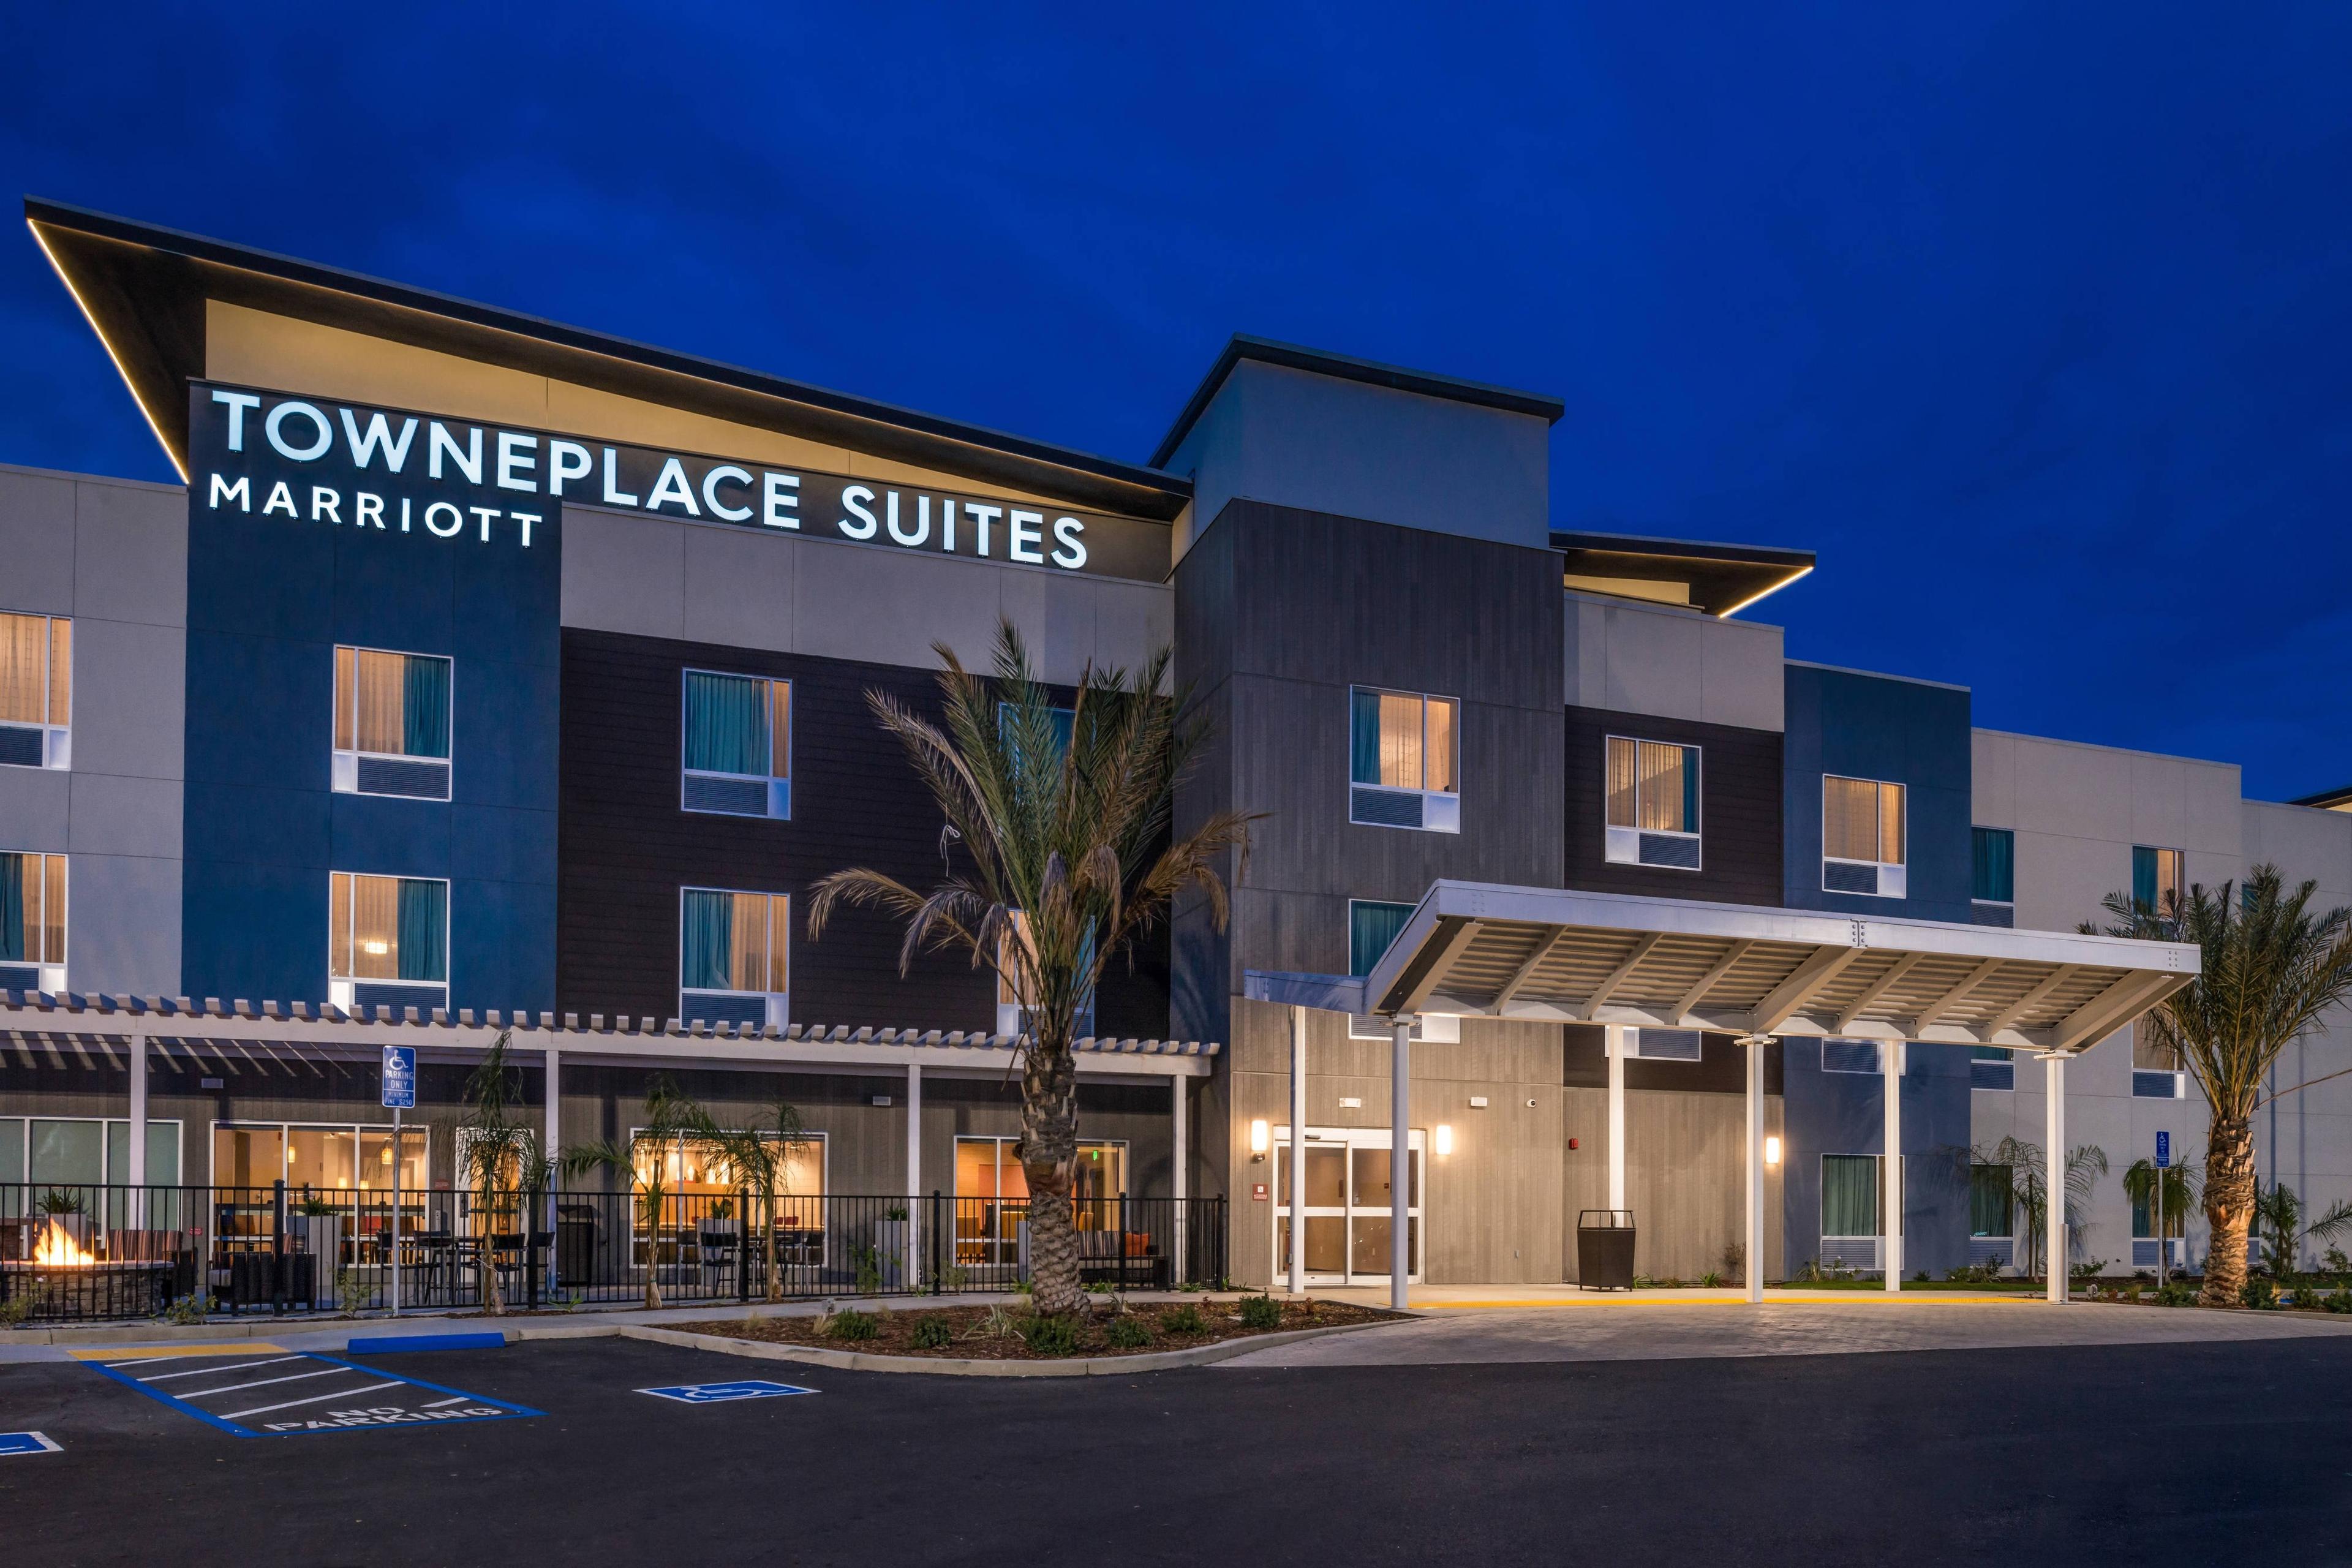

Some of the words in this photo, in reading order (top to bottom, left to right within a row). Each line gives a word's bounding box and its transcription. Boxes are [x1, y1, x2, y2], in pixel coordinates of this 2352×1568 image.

[212, 390, 800, 530] TOWNEPLACE
[837, 484, 1088, 570] SUITES
[208, 473, 543, 547] MARRIOTT
[385, 1069, 413, 1080] PARKING
[391, 1080, 408, 1089] ONLY
[263, 1408, 502, 1431] PARKING
[326, 1407, 405, 1419] NO
